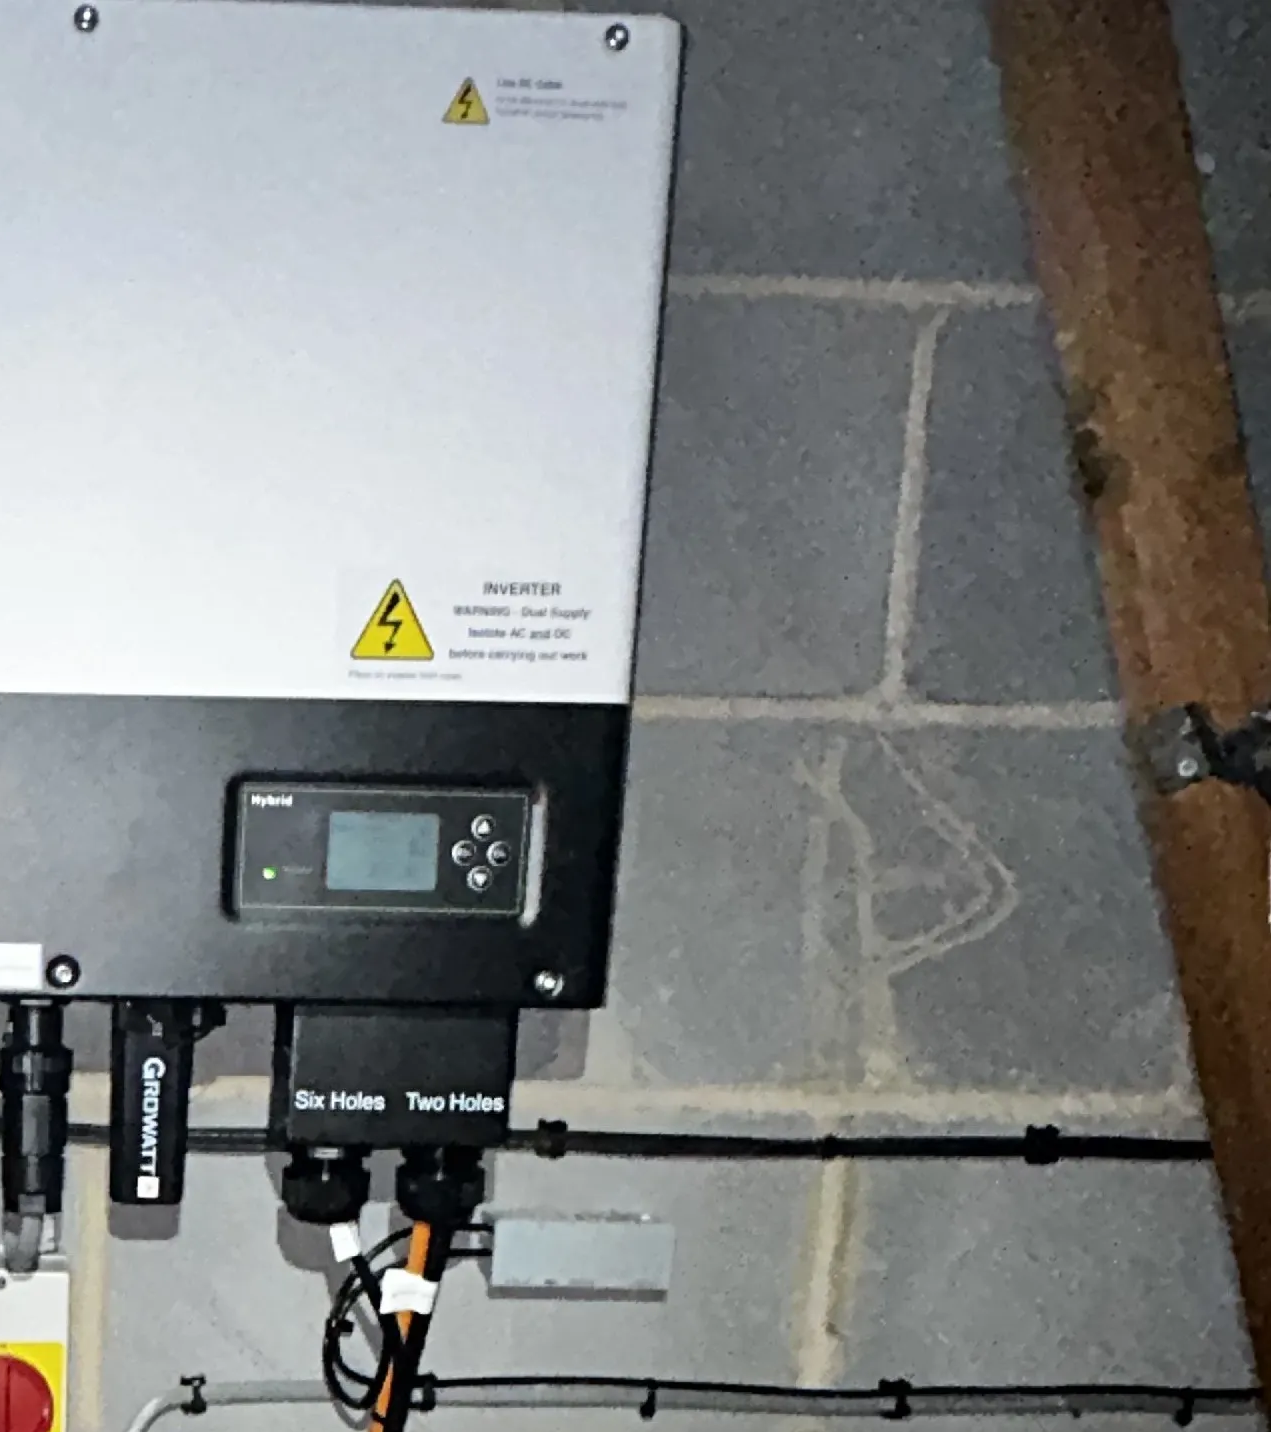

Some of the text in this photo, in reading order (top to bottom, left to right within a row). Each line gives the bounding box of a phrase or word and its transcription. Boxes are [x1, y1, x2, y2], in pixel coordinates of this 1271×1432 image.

[482, 581, 562, 596] INVERTER
[453, 605, 511, 617] WARNING
[521, 605, 547, 618] Dual
[550, 606, 592, 620] Supply
[510, 627, 526, 639] AC
[529, 629, 551, 640] and
[553, 628, 571, 640] DC
[448, 648, 485, 660] before
[488, 649, 536, 662] carrying
[560, 650, 587, 661] work
[251, 793, 293, 809] Hybrid
[294, 1090, 505, 1113] Six Holes Two Holes
[140, 1056, 167, 1177] GROWATT
